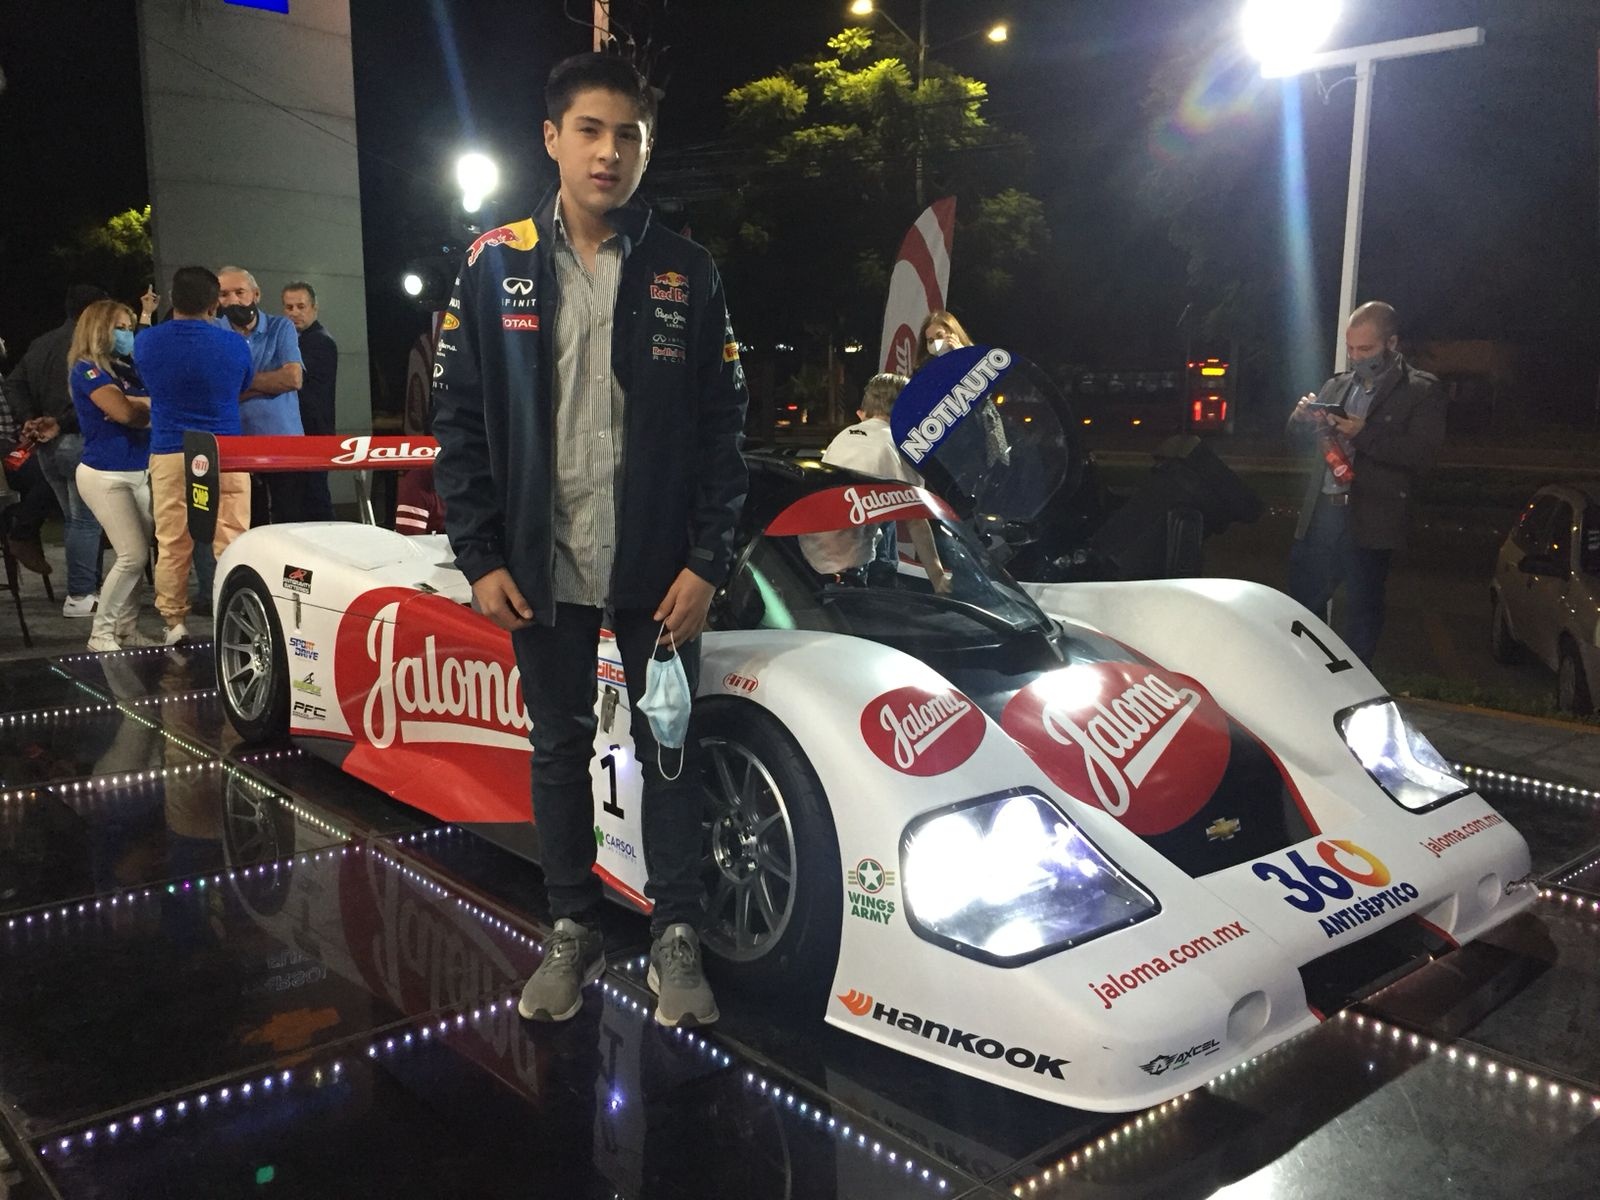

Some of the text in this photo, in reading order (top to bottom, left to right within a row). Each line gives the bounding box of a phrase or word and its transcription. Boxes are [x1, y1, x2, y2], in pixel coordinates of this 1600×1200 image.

[900, 347, 1012, 465] NOTIAUTO
[844, 487, 923, 525] Jaloma
[294, 647, 319, 661] DRIVE
[1291, 619, 1353, 674] 1
[293, 701, 327, 718] PFC
[880, 688, 972, 770] Jaloma
[1042, 671, 1202, 817] Jaloma
[600, 752, 625, 820] 1
[605, 833, 637, 859] CARSOL
[1419, 812, 1504, 859] jaloma.com.mx
[1251, 839, 1391, 914] 360
[851, 904, 891, 925] ARMY
[1088, 921, 1250, 1010] jaloma.com.mx
